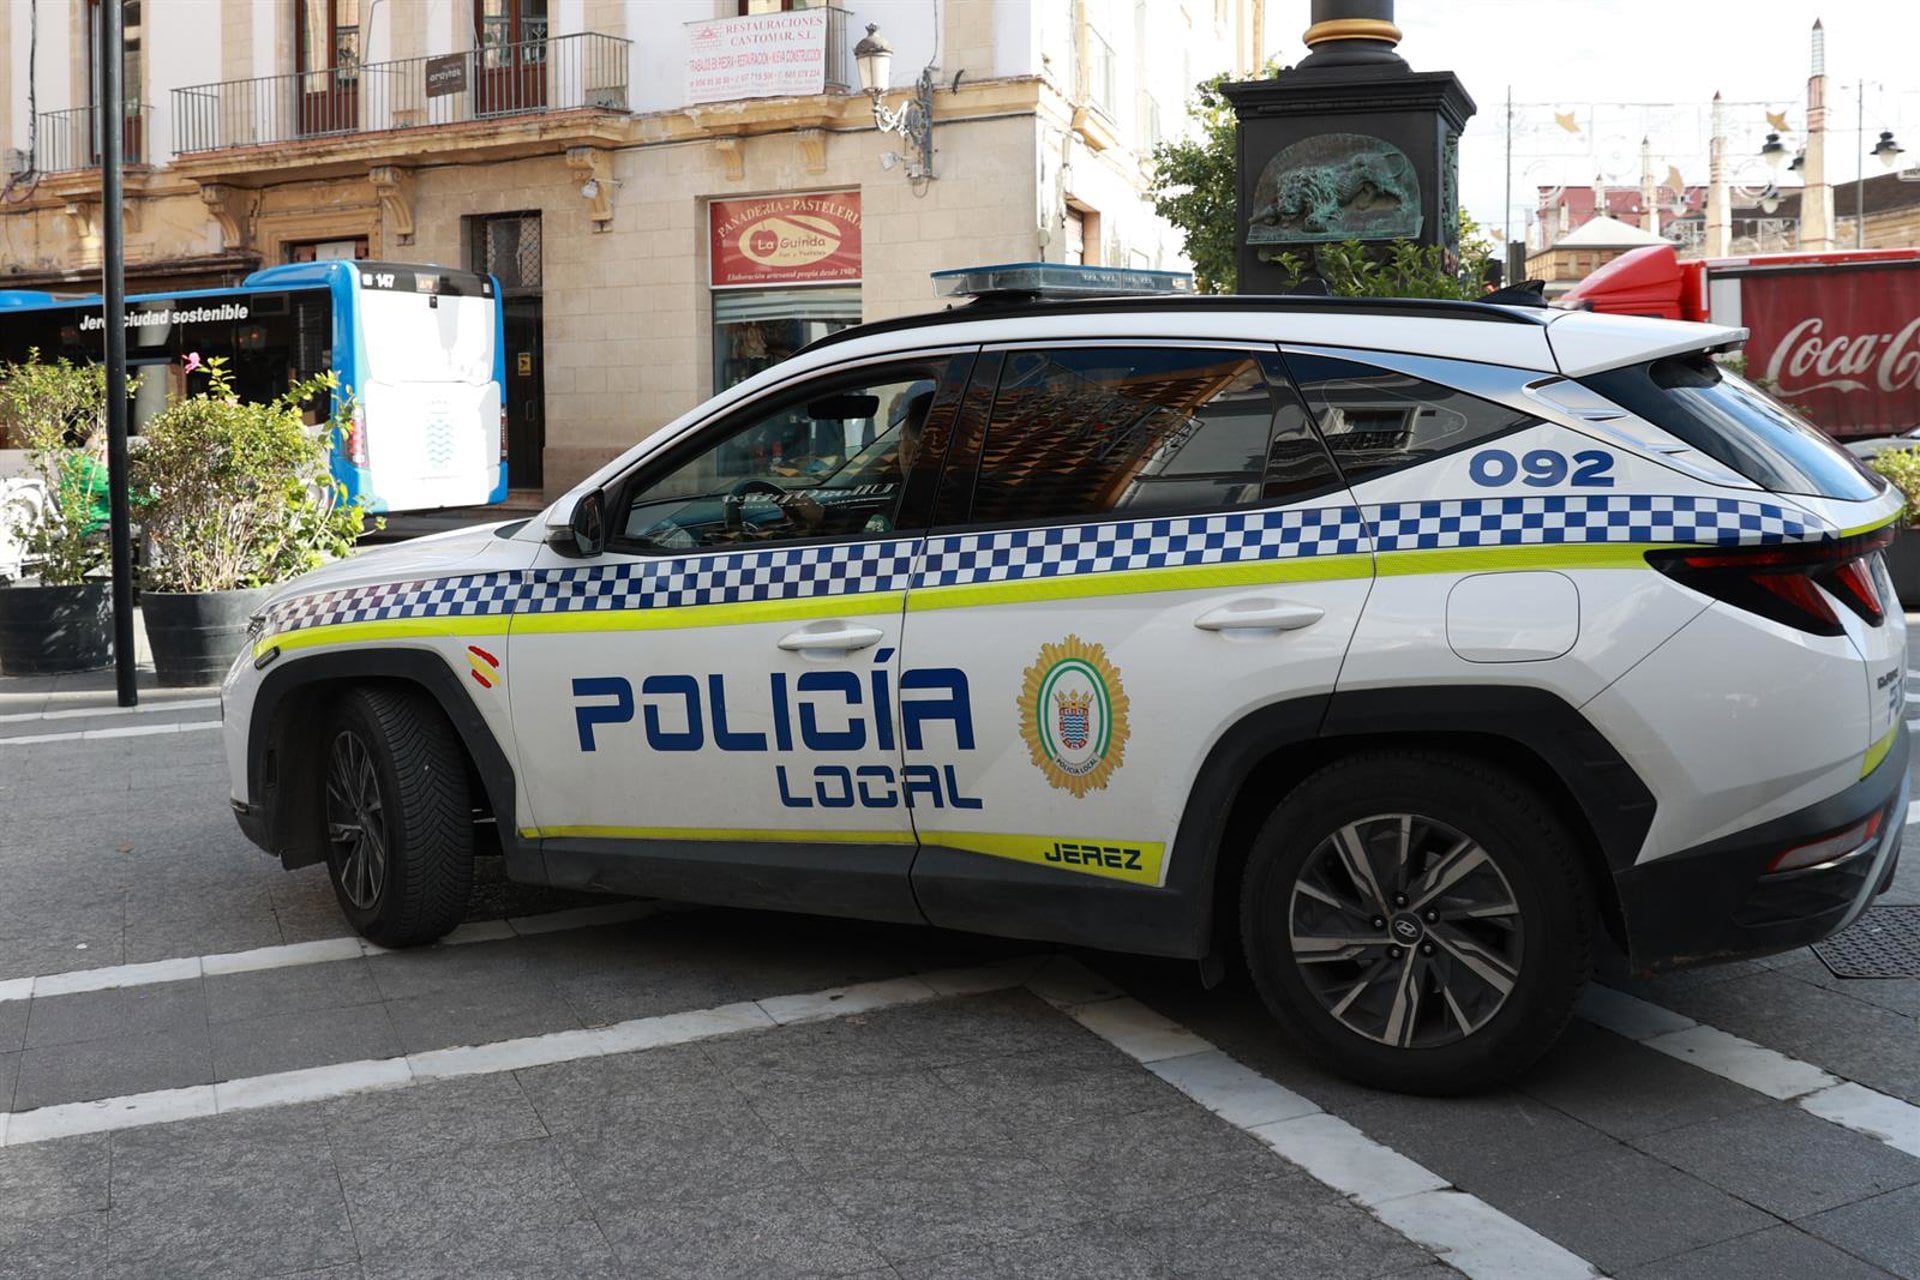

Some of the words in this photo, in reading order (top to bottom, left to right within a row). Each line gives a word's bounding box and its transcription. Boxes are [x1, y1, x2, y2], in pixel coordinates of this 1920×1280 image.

[726, 16, 823, 34] RESTAURACIONES
[798, 29, 816, 40] S.L.
[718, 201, 784, 238] PANADERIA
[758, 239, 774, 250] La
[780, 235, 826, 249] Guinda
[376, 273, 395, 287] 147
[172, 304, 248, 324] sostenible
[1766, 315, 1920, 397] Coca-C
[1469, 449, 1614, 487] 092
[572, 647, 975, 751] POLICÍA
[1080, 758, 1098, 774] LOCAL
[776, 765, 983, 809] LOCAL
[1044, 842, 1142, 871] JEREZ
